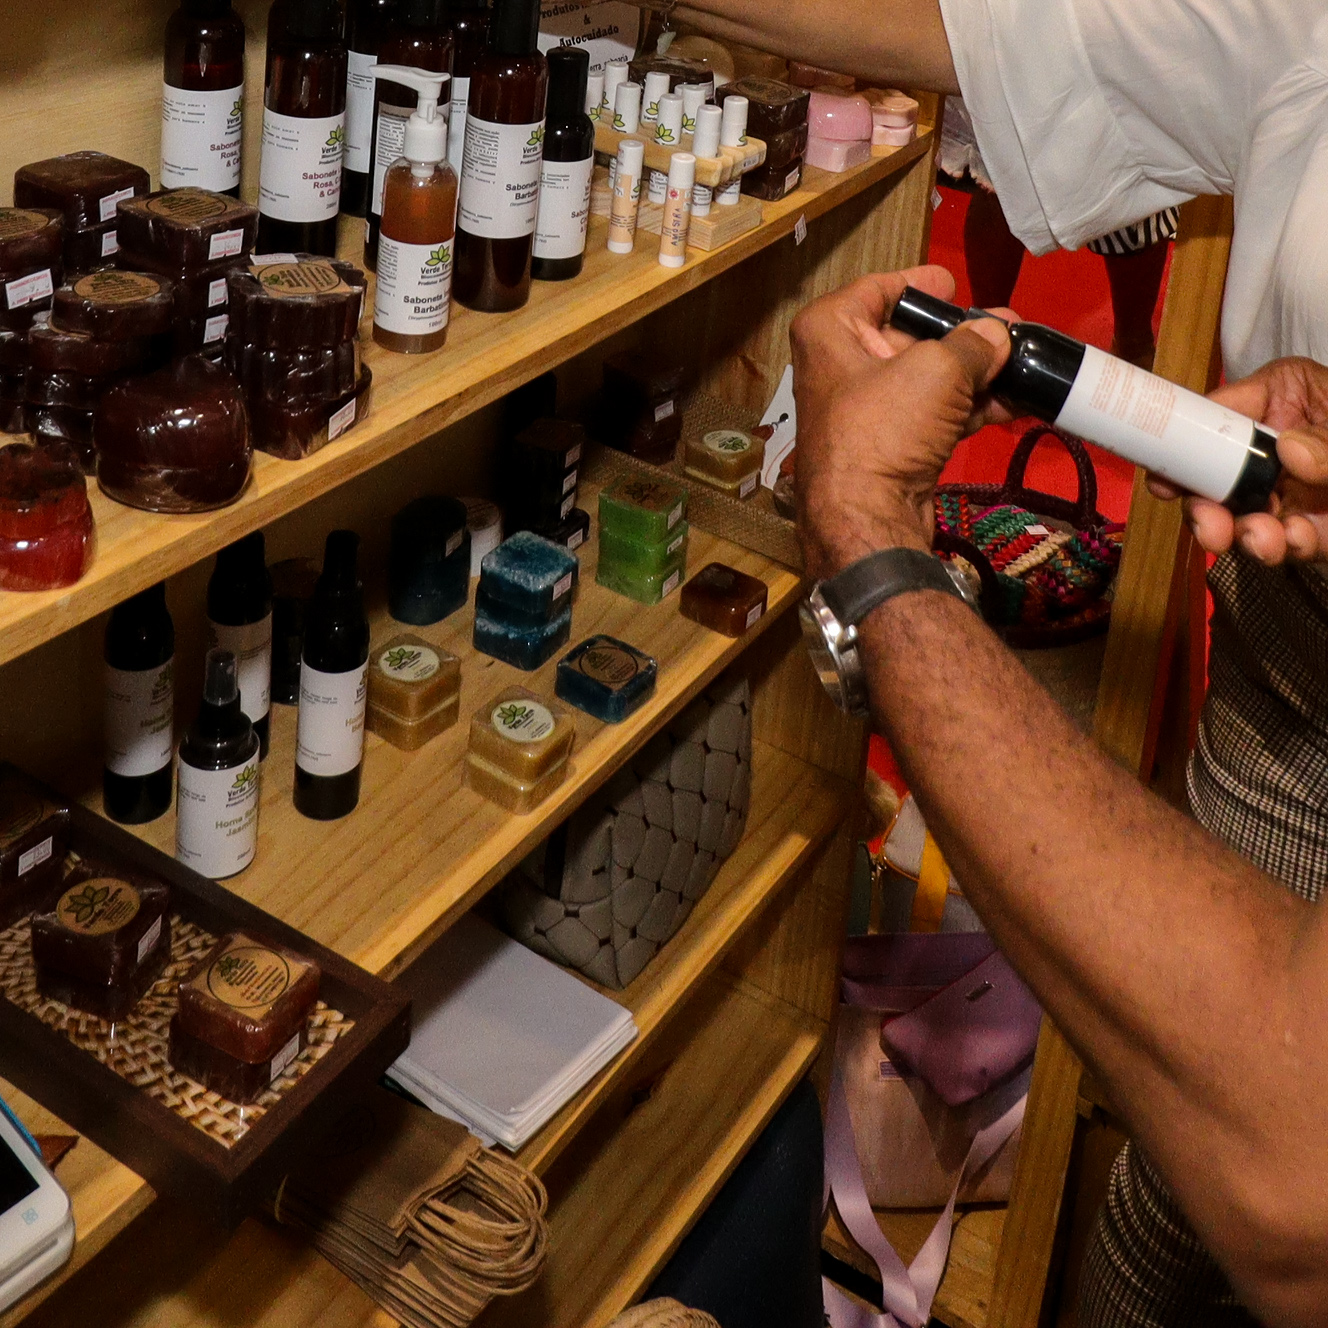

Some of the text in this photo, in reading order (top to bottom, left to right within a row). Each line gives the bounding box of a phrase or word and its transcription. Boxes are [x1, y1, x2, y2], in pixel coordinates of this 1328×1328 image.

[539, 4, 579, 19] rodutos
[584, 14, 590, 25] &
[559, 25, 619, 47] Autocuidado
[322, 145, 337, 153] Verde
[522, 146, 538, 154] Verde
[313, 181, 334, 189] Rosa,
[421, 266, 440, 274] Verde
[404, 294, 442, 303] Sabonete
[216, 817, 242, 829] Home
